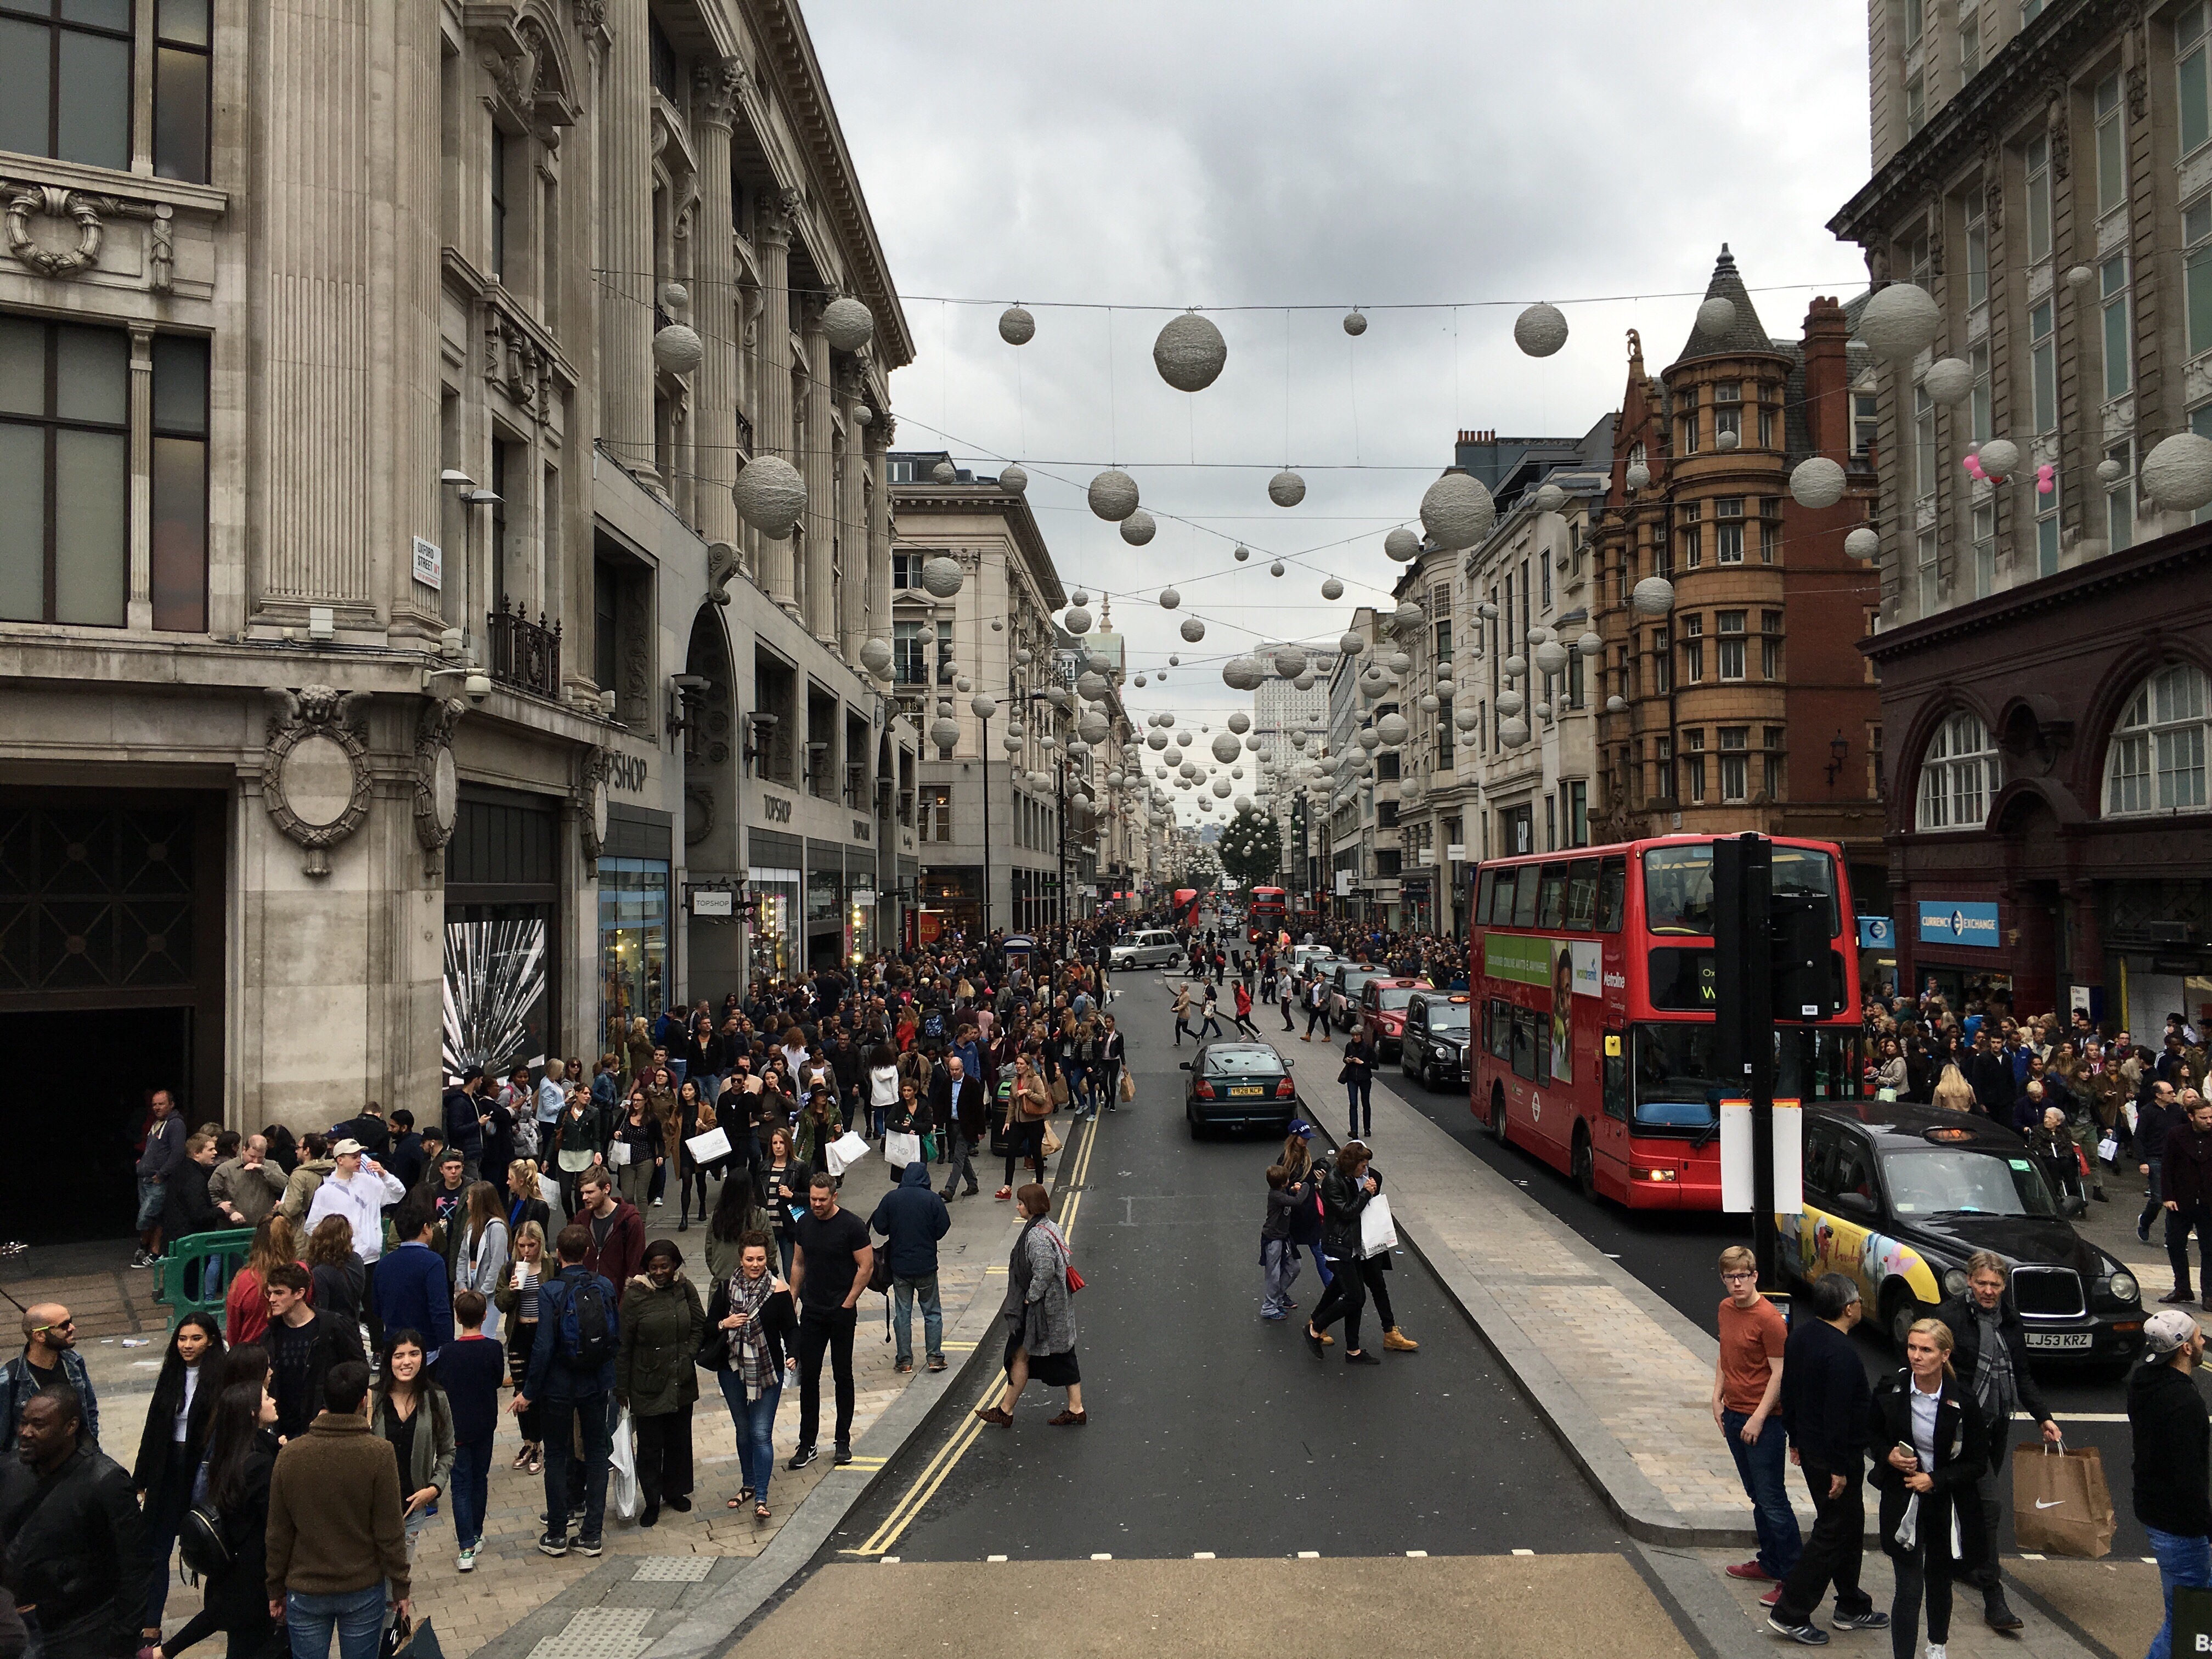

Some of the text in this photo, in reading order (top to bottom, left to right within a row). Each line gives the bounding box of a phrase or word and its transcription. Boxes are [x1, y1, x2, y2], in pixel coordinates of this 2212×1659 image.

[418, 542, 434, 559] OXFORD
[418, 555, 439, 575] STREET W1
[606, 753, 647, 792] PSHOP
[764, 794, 791, 823] TOPSHOP
[1922, 917, 1995, 929] CURRENCY EXCHANGE
[1604, 970, 1624, 989] Metroline
[697, 1138, 724, 1153] TOPSHOP
[2027, 1334, 2087, 1346] LJ53 KRZ
